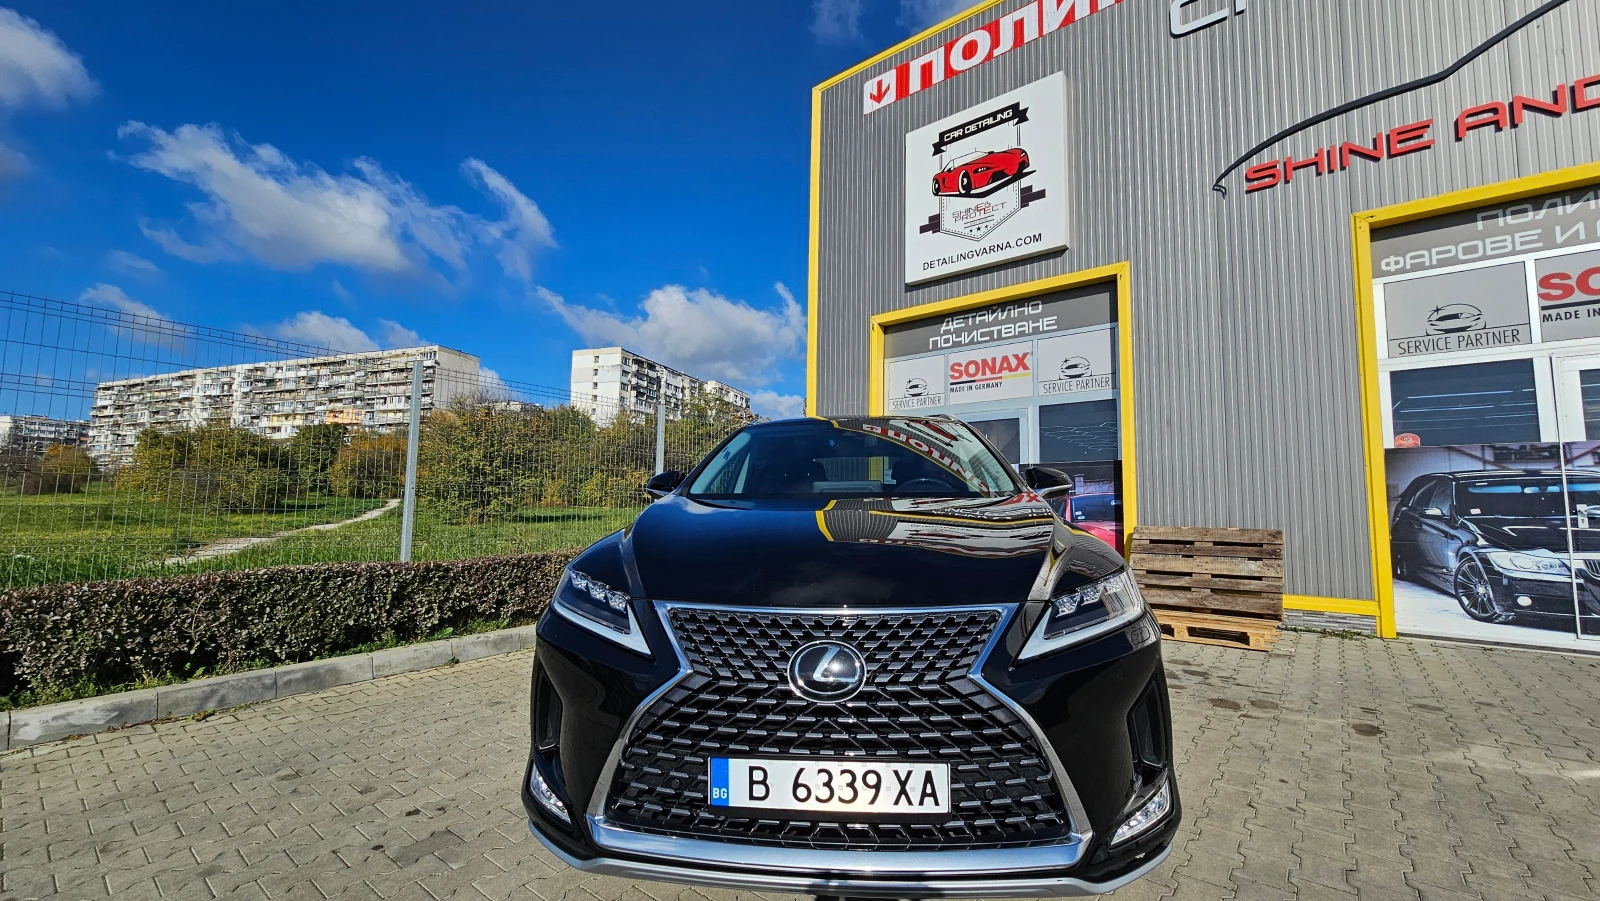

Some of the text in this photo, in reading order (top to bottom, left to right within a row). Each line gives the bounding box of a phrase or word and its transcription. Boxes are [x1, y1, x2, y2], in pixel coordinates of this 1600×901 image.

[944, 109, 1013, 142] CAR DETAILING
[1245, 118, 1436, 192] SHINE
[922, 232, 1042, 271] DETAILINGVARNA.COM
[1380, 228, 1544, 272] ФАРОВЕ
[1554, 221, 1586, 244] И
[940, 300, 1043, 334] ДЕТАЙЛНО
[1542, 310, 1581, 323] MADE
[929, 315, 1058, 350] ПОЧИСТВАНЕ
[1397, 328, 1521, 355] SERVICE PARTNER
[949, 351, 1031, 381] SONAX
[950, 381, 1003, 393] MADE IN GERMANY
[1043, 376, 1111, 394] SERVICE PARTNER
[892, 396, 942, 410] SERVICE PARTNER
[712, 787, 728, 799] BG
[748, 765, 941, 807] B 6339 XA
